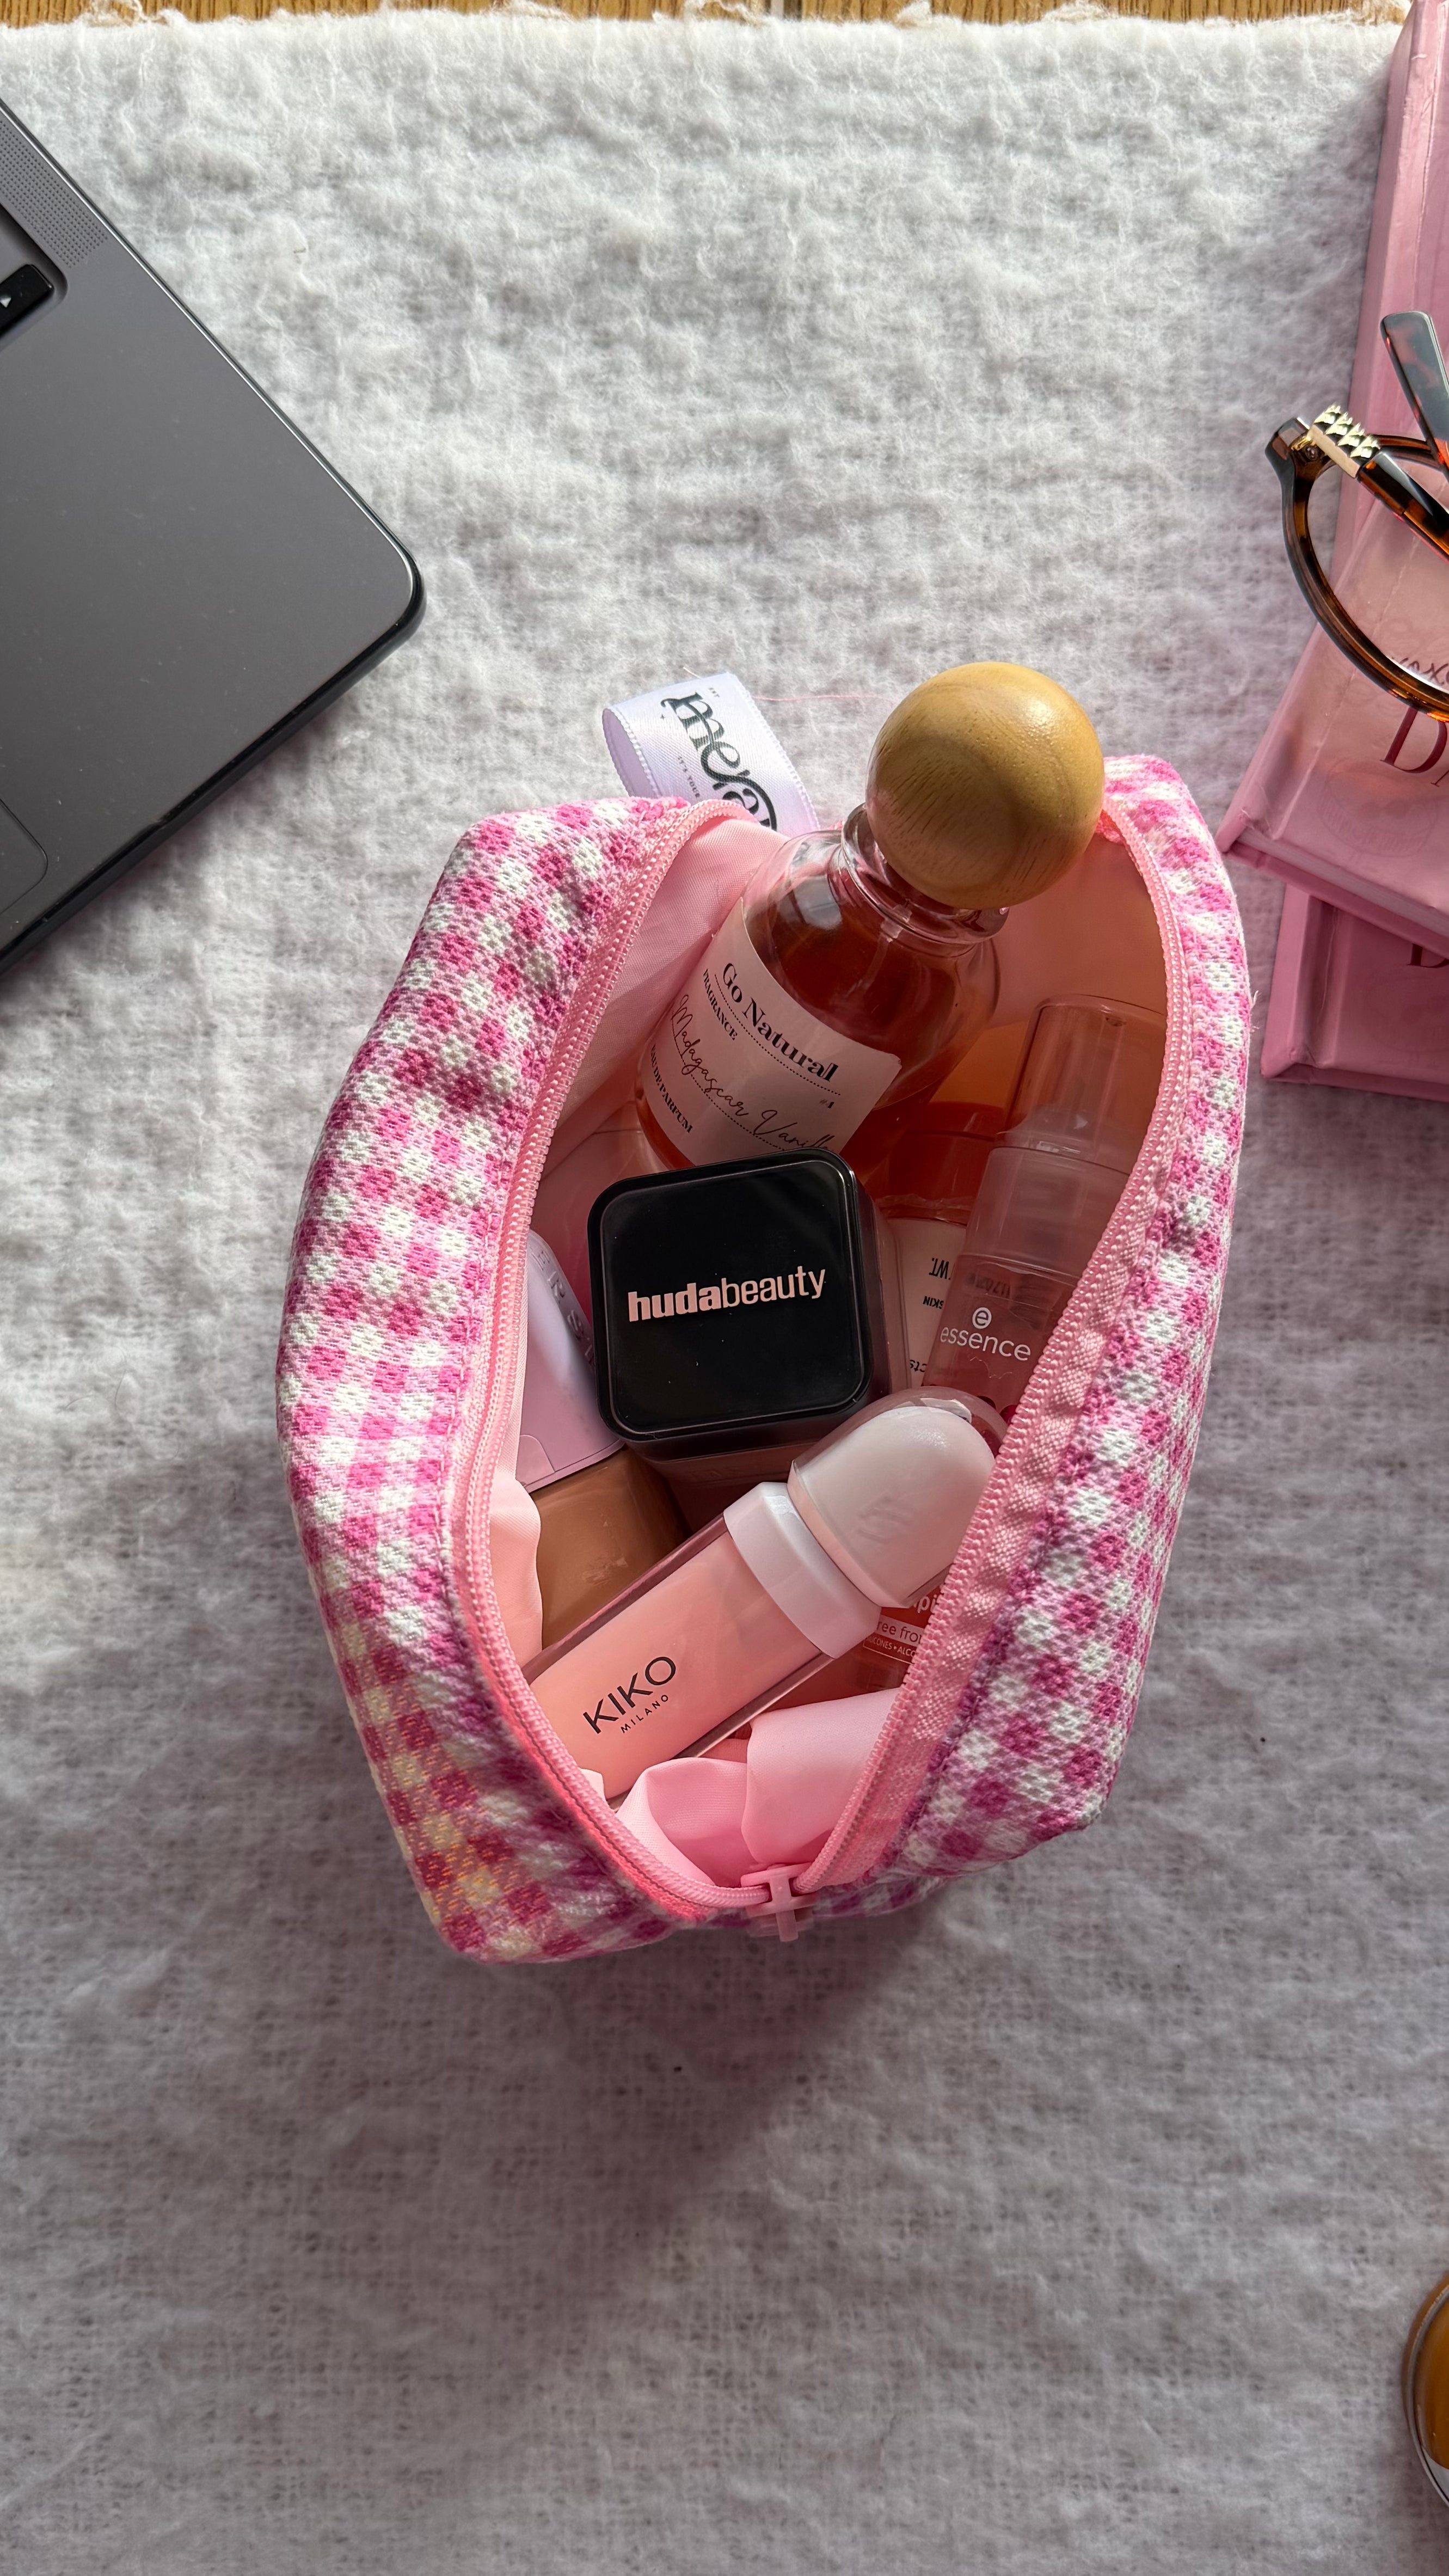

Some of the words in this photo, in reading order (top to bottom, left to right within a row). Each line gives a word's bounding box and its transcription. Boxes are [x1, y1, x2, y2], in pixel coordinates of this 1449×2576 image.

[660, 692, 777, 832] mera
[687, 775, 701, 799] YOUR
[703, 968, 738, 1041] FRAGRANCE
[722, 962, 743, 1003] Go
[741, 997, 839, 1083] Natural
[671, 994, 750, 1117] Madagascar
[753, 1109, 836, 1148] Vanill
[659, 1083, 693, 1133] PARFUM
[628, 1265, 826, 1322] hudabeauty
[928, 1257, 949, 1280] WT.
[923, 1296, 944, 1309] SKIN
[940, 1327, 1032, 1361] essence
[877, 1621, 897, 1635] ree
[582, 1656, 676, 1734] KIKO
[621, 1694, 668, 1733] MILANO
